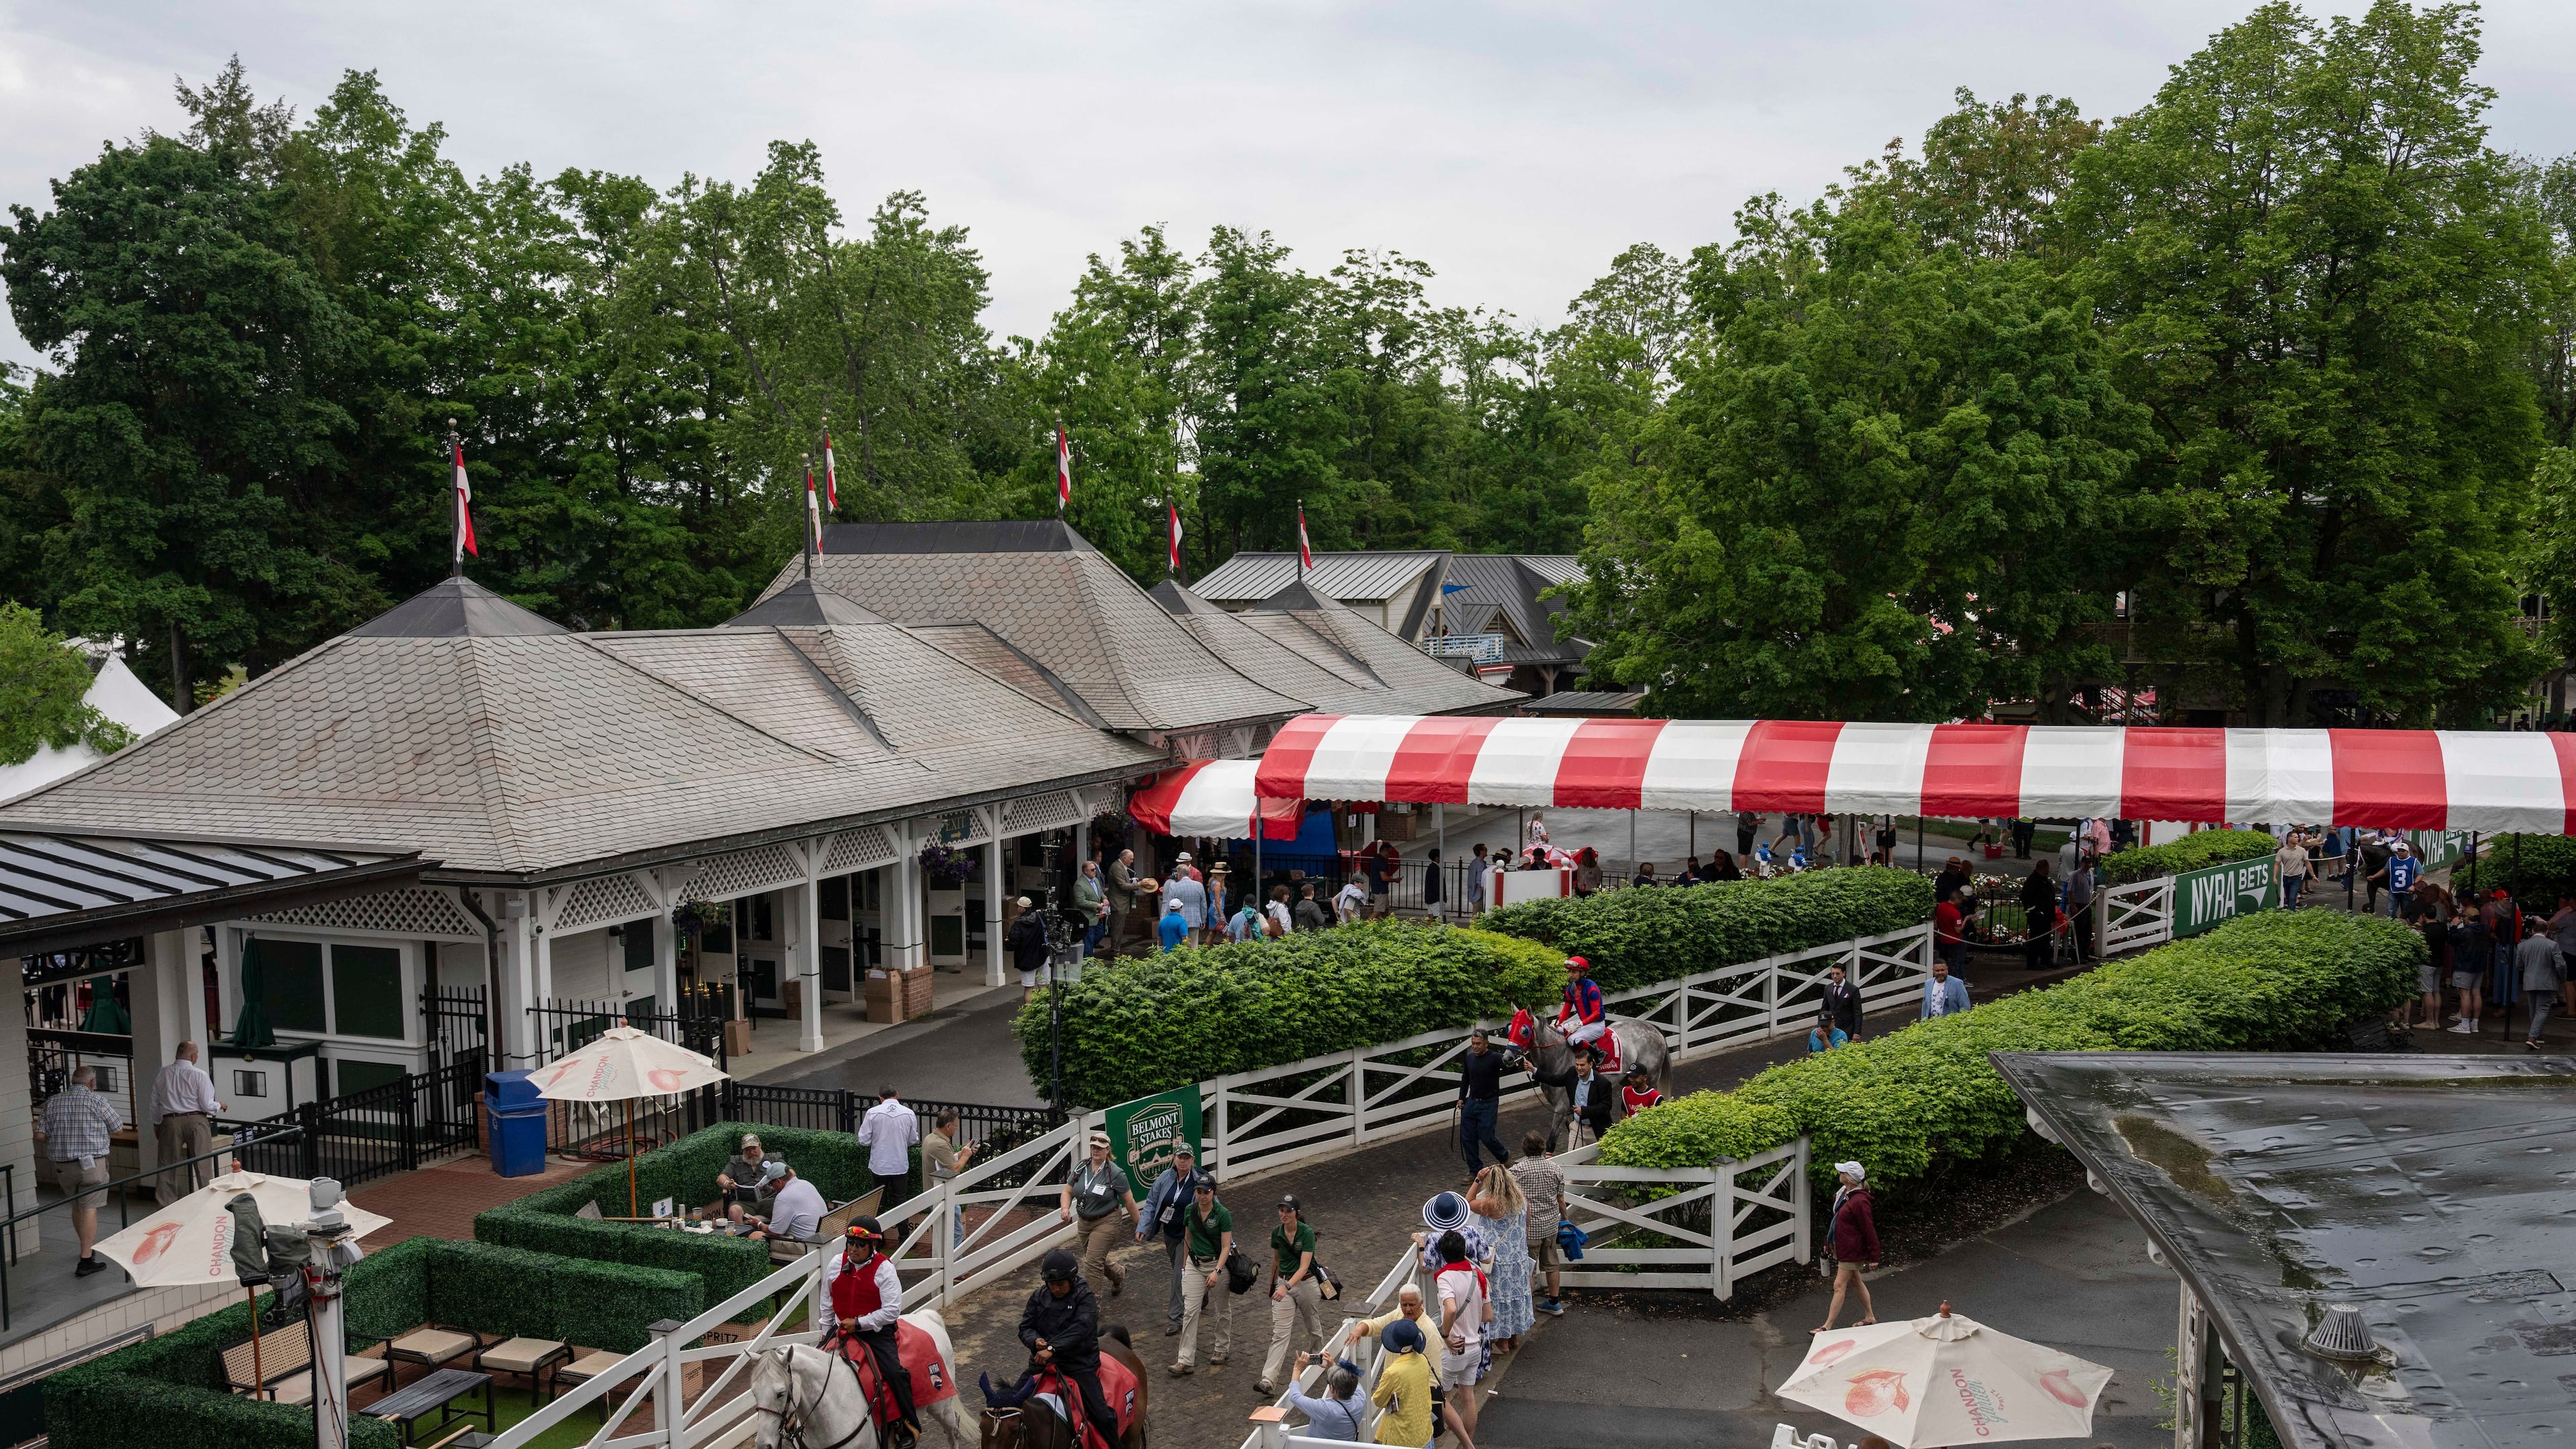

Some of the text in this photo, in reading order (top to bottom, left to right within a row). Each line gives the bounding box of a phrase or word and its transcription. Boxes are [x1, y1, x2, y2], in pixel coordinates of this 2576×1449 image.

[946, 816, 966, 832] EXIT
[2238, 863, 2269, 890] BETS
[2394, 869, 2407, 888] 3
[2190, 871, 2235, 926] NYRA
[1611, 1032, 1620, 1058] 1
[586, 1056, 609, 1097] CHANDON
[1132, 1112, 1179, 1136] BELMONT
[1140, 1126, 1172, 1147] STAKES
[209, 1216, 227, 1277] CHANDON
[928, 1363, 940, 1375] NYRA
[1950, 1368, 1990, 1436] CHANDON
[1990, 1389, 2005, 1411] SPRITZ
